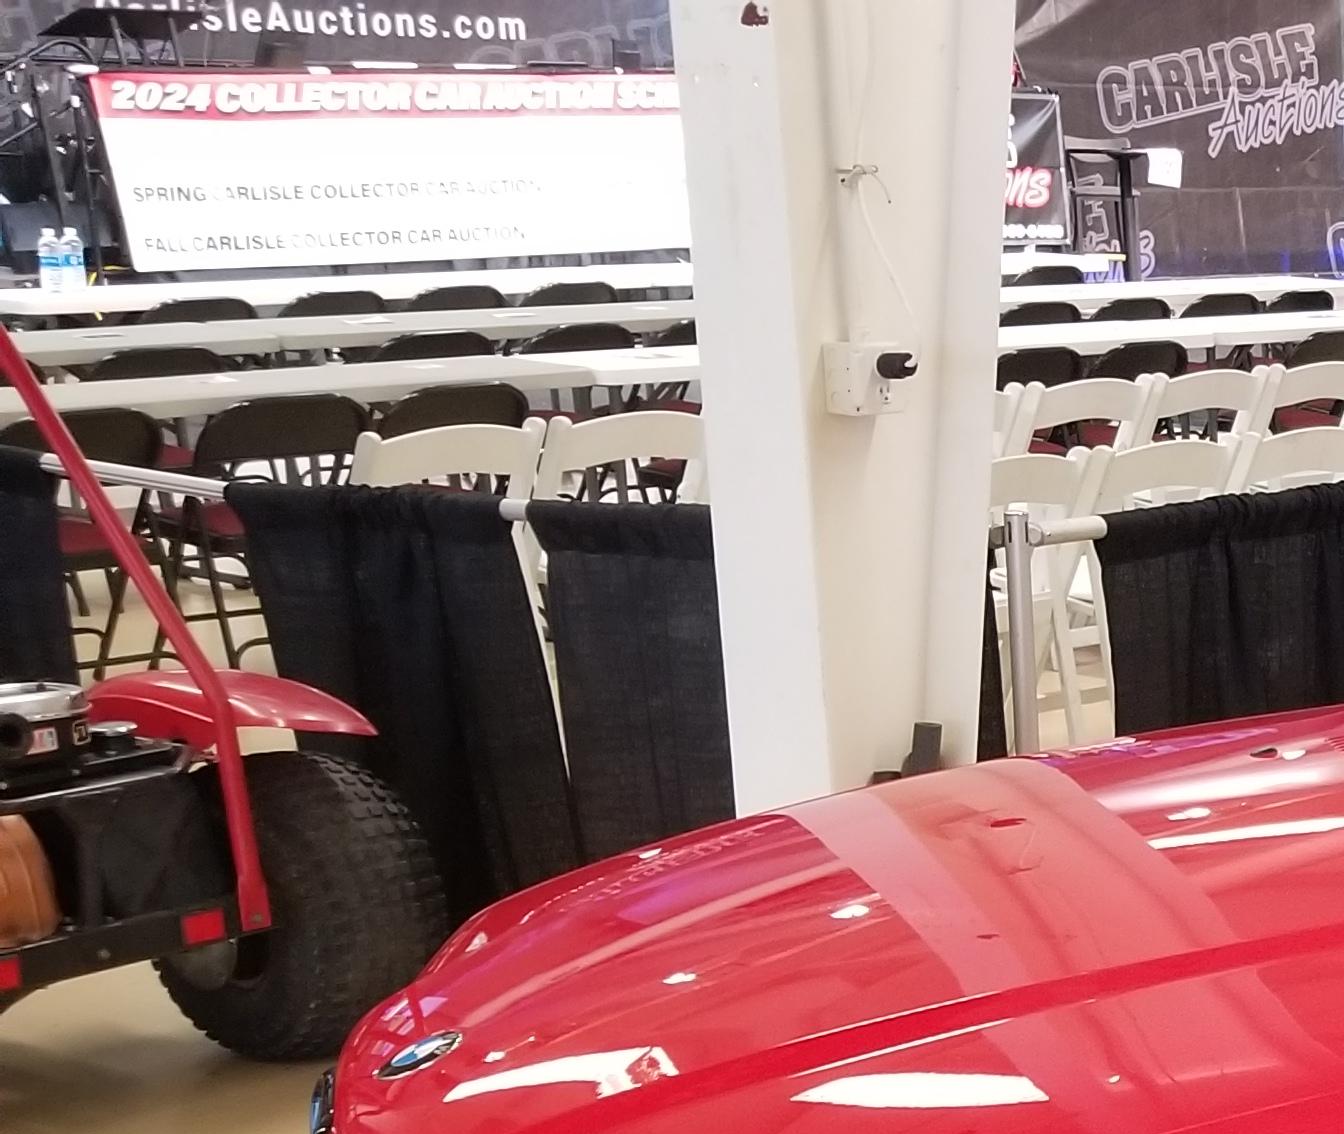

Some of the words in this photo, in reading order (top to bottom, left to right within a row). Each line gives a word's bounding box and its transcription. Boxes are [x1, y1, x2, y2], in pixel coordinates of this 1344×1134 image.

[1097, 23, 1318, 133] CARLISLE
[110, 80, 211, 112] 2024
[213, 82, 413, 113] COLLECTOR
[414, 82, 481, 111] CAR
[482, 81, 615, 111] AUCTION
[133, 186, 207, 202] SPRING
[212, 184, 304, 201] ARLISLE
[310, 183, 419, 199] COLLECTOR
[144, 237, 188, 252] FALL
[192, 234, 286, 251] CARLISLE
[407, 228, 442, 244] CAR
